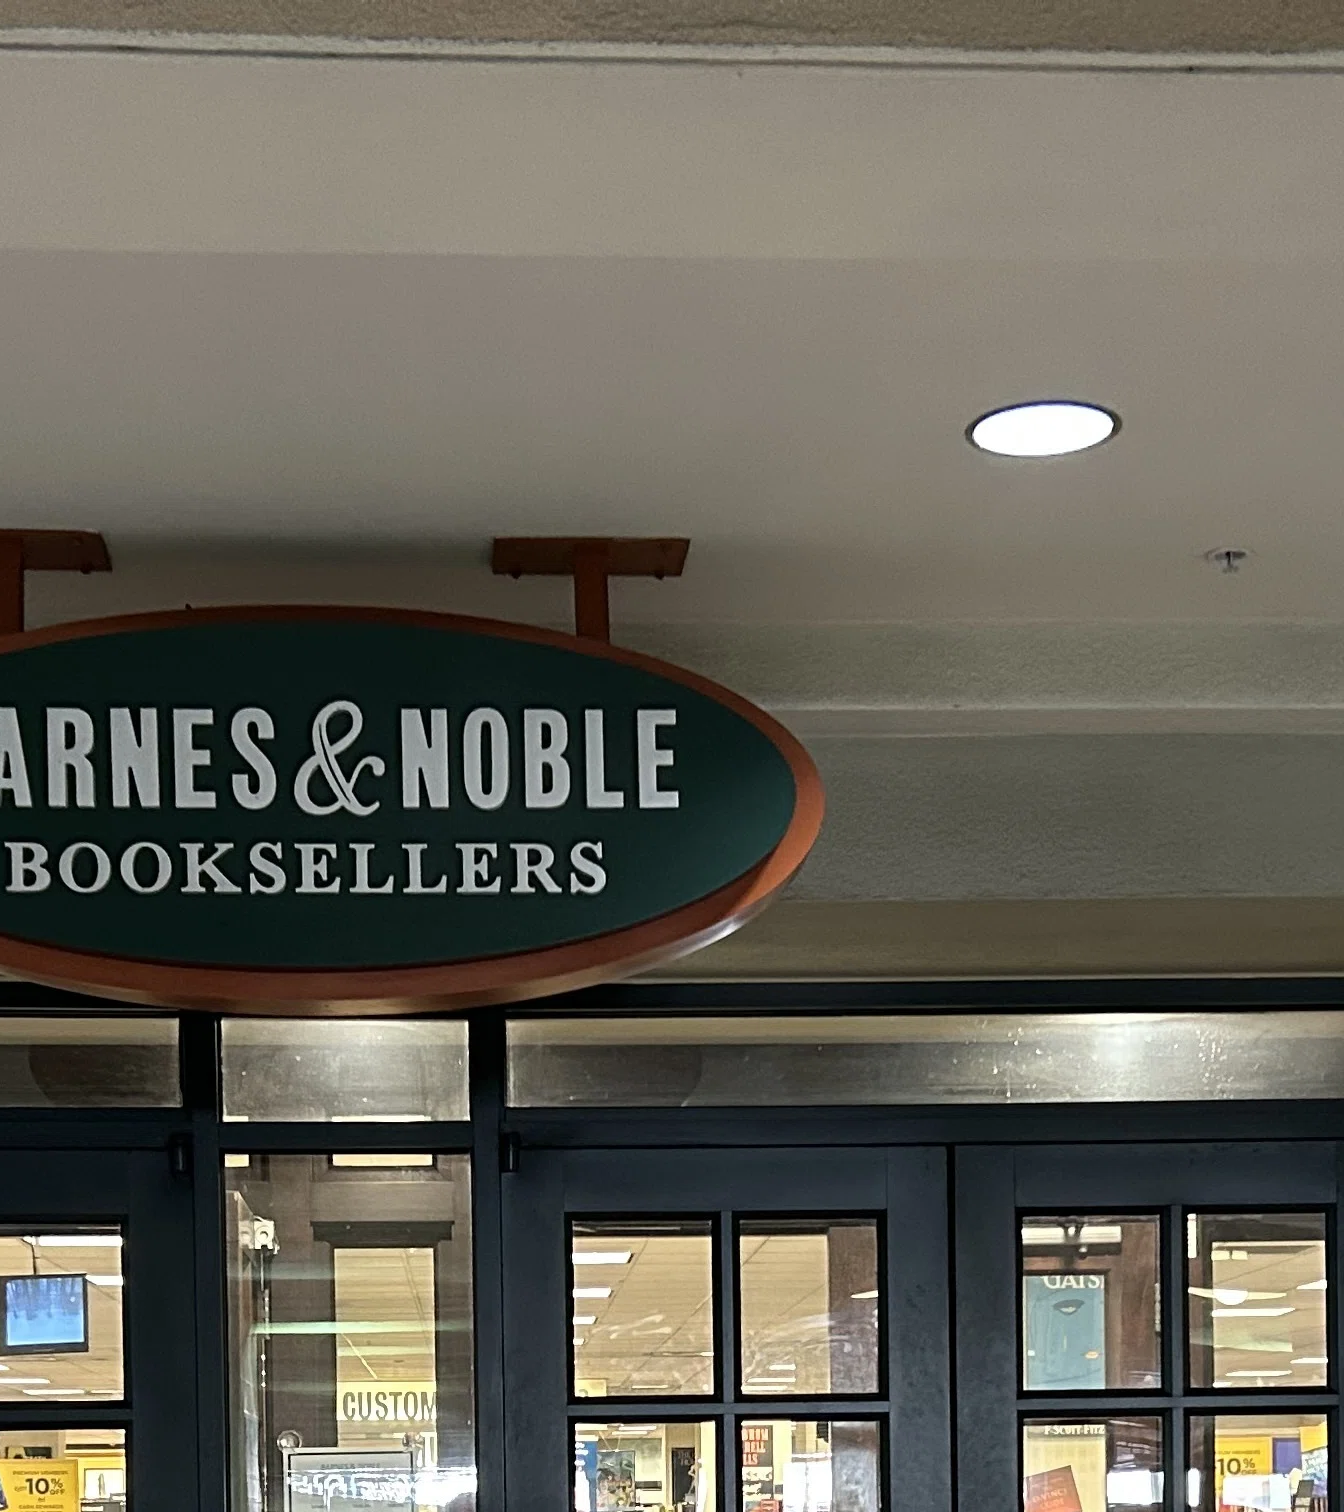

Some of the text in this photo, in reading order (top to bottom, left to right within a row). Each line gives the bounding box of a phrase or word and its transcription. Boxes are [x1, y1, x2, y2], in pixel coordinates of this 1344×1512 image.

[293, 699, 381, 816] &
[400, 706, 680, 809] NOBLE
[3, 840, 608, 896] BOOKSELLERS
